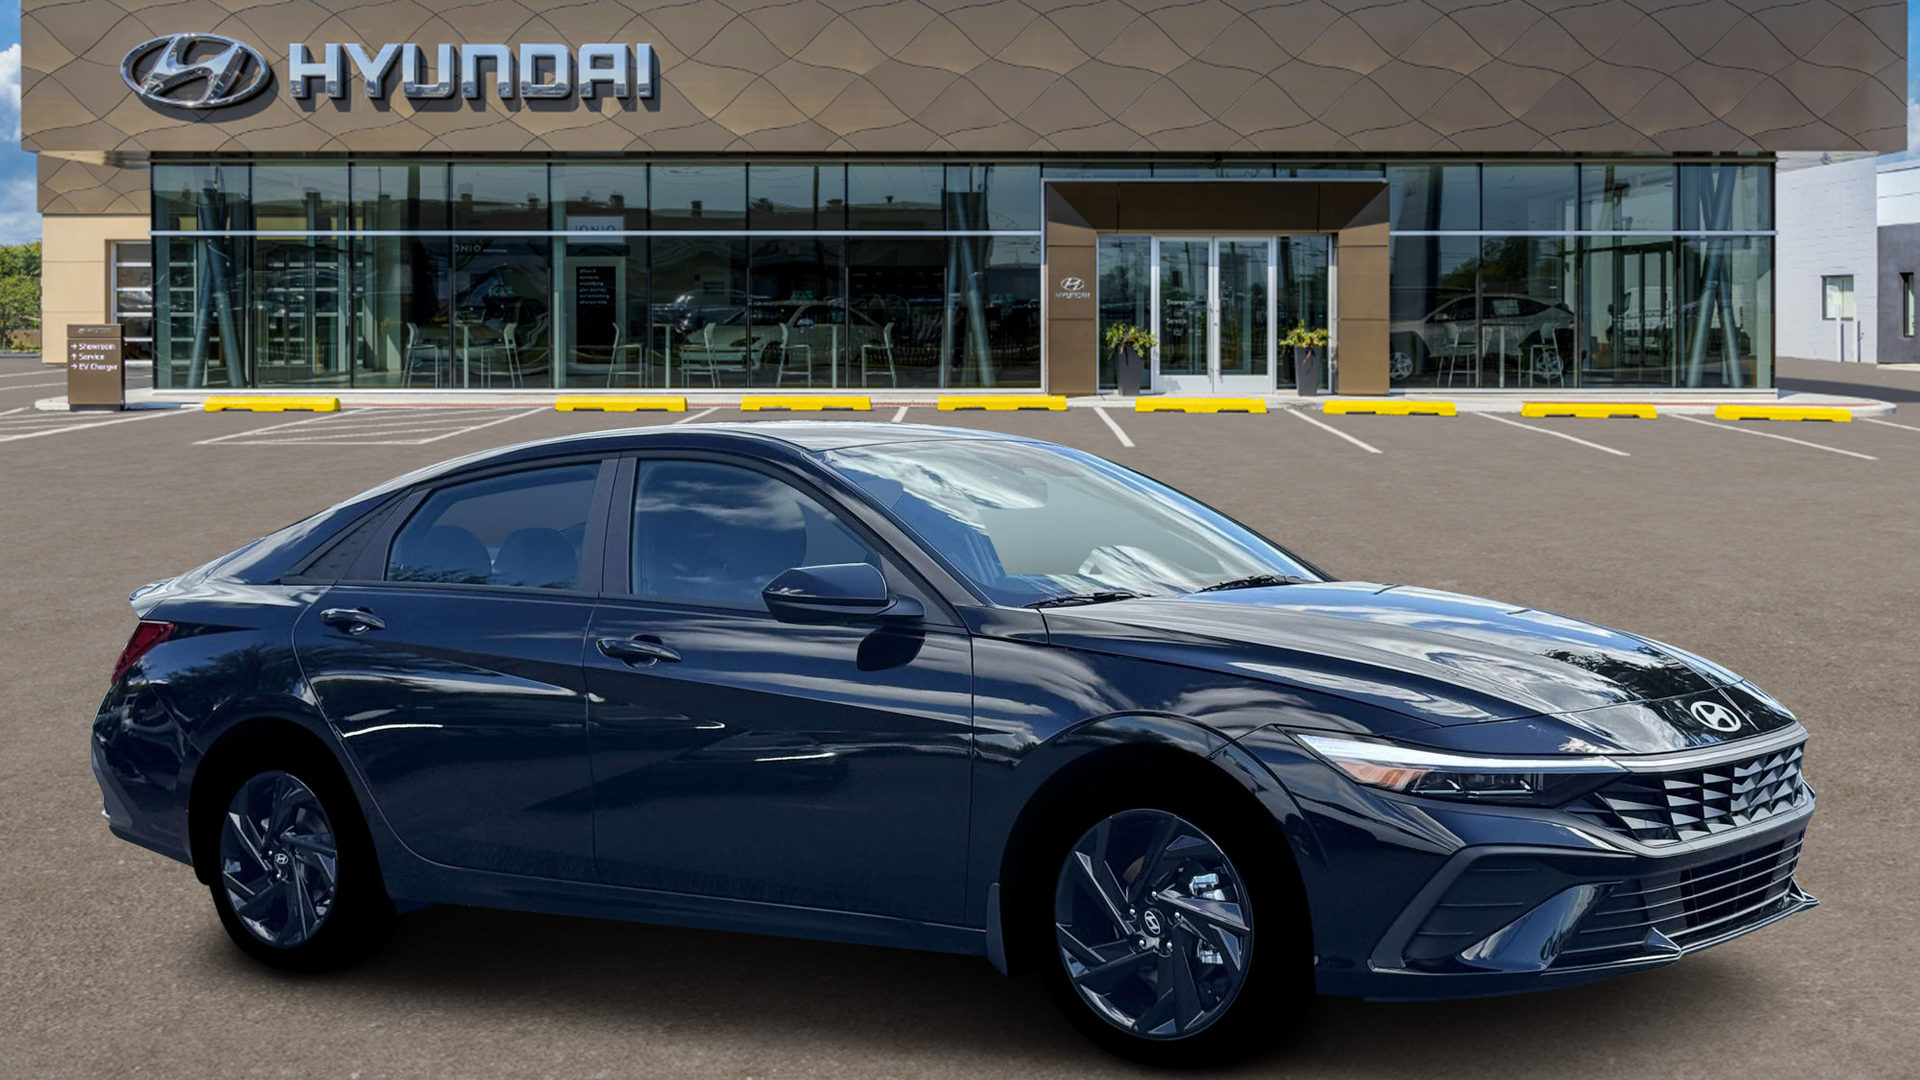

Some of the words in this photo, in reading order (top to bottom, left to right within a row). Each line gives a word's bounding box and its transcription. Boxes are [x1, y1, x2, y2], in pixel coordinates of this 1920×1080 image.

[289, 43, 654, 99] HYUNDAI
[78, 352, 105, 360] Service
[90, 363, 118, 372] Charger
